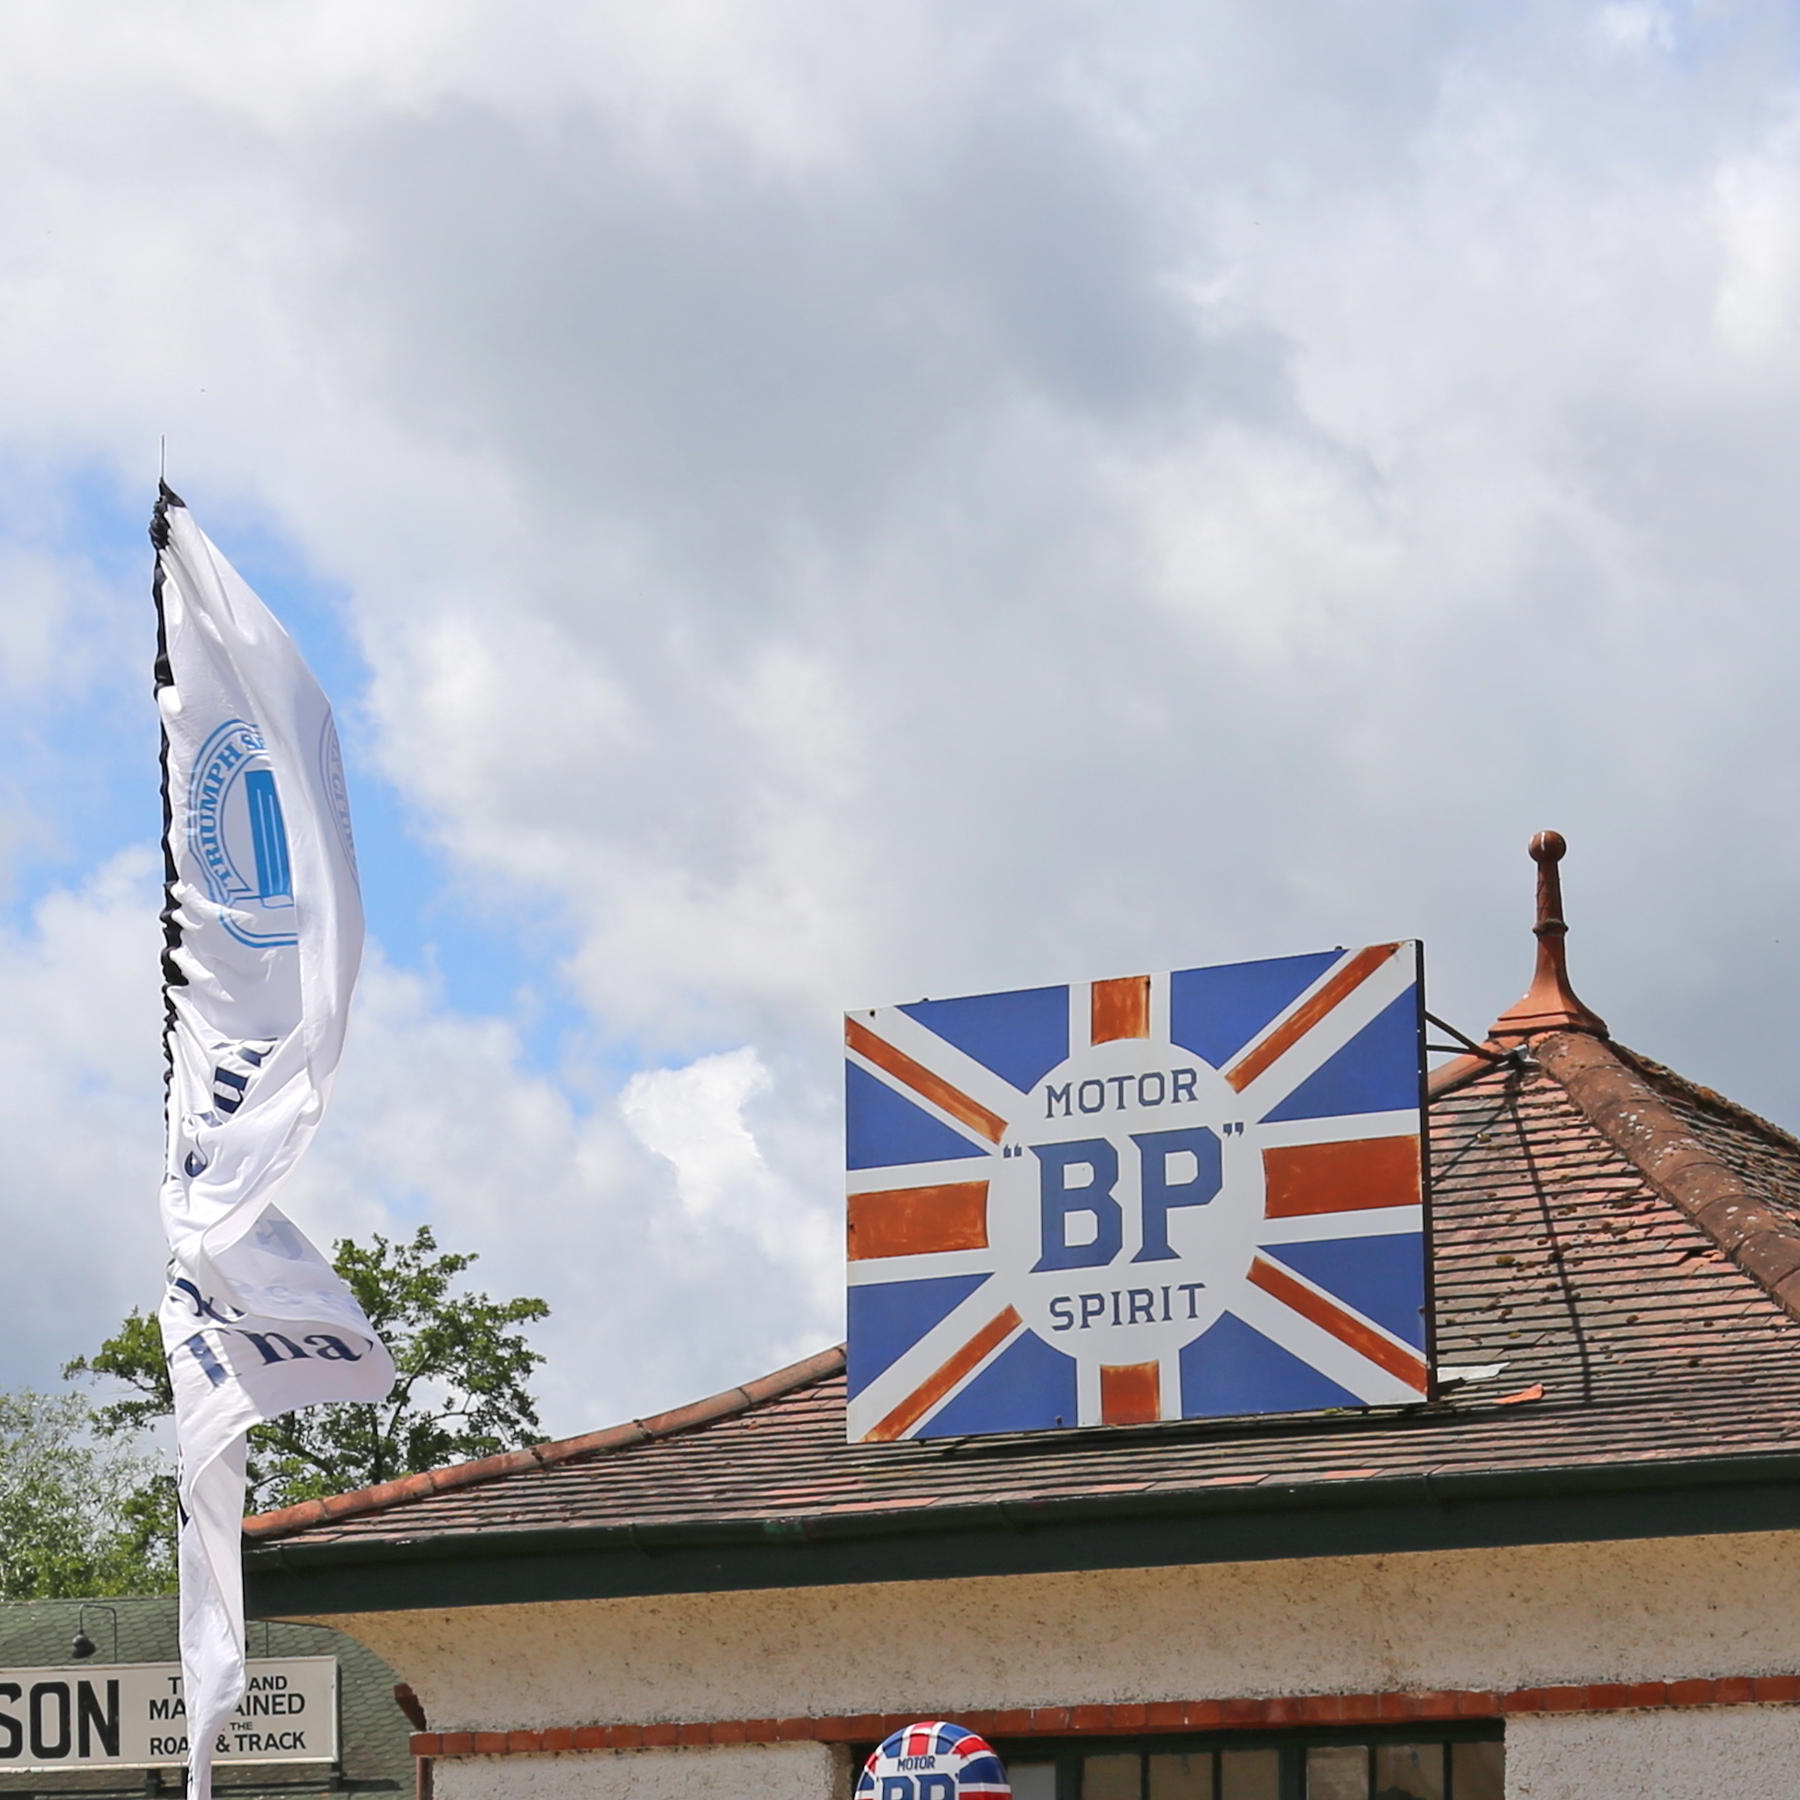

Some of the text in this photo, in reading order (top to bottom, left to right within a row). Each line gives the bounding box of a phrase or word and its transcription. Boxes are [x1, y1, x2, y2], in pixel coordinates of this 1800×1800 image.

[199, 742, 244, 887] TRIUMPH
[1045, 1067, 1199, 1119] MOTOR
[1048, 1282, 1206, 1332] SPIRIT
[248, 1675, 288, 1692] AND
[229, 1721, 253, 1731] THE
[215, 1733, 231, 1753] &
[234, 1731, 307, 1753] TRACK
[896, 1755, 936, 1772] MOTOR
